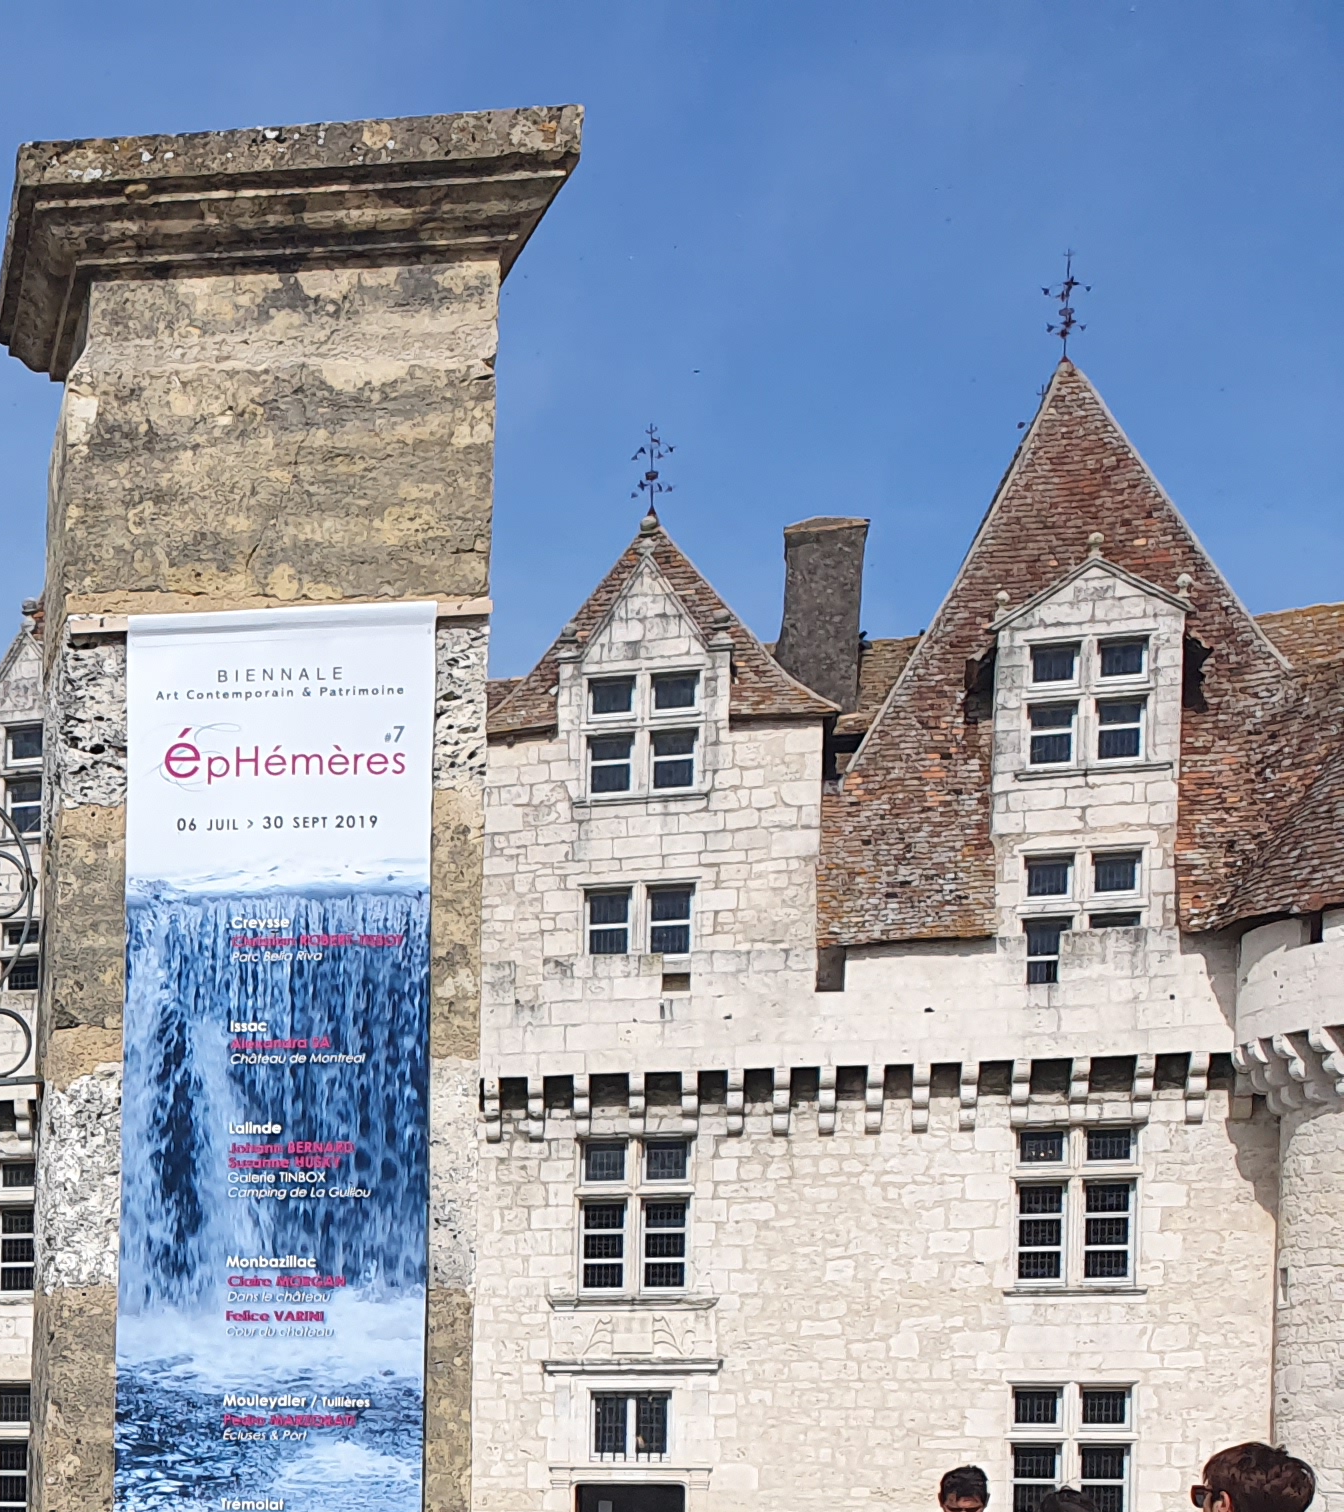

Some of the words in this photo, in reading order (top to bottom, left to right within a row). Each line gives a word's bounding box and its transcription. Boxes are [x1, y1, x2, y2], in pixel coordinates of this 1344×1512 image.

[217, 666, 344, 683] BIENNALE
[156, 690, 180, 701] Art
[186, 687, 294, 701] Contemporain
[302, 686, 312, 698] &
[319, 685, 404, 697] Patrimoine
[384, 725, 406, 743] #7
[164, 727, 406, 785] épHémères
[176, 817, 197, 832] 06
[206, 818, 239, 831] JUIL
[262, 815, 284, 830] 30
[292, 815, 328, 829] SEPT
[334, 814, 379, 829] 2019
[231, 917, 290, 930] Creysse
[231, 951, 259, 963] Parc
[296, 950, 323, 962] Riva
[230, 1020, 268, 1033] Issac
[230, 1037, 308, 1050] Alexandra
[230, 1052, 286, 1065] Château
[289, 1052, 307, 1064] de
[229, 1121, 282, 1135] Lalinde
[228, 1142, 284, 1155] Johann
[287, 1141, 356, 1154] BERNARD
[228, 1156, 290, 1169] Suzanne
[295, 1155, 341, 1168] HUSKY
[227, 1171, 276, 1184] Galerie
[278, 1171, 326, 1183] TINBOX
[227, 1187, 287, 1200] Camping
[289, 1187, 307, 1198] de
[310, 1187, 326, 1198] La
[225, 1255, 317, 1268] Monbazillac
[227, 1275, 272, 1288] Claire
[276, 1274, 347, 1288] MORGAN
[227, 1291, 259, 1303] Dans
[262, 1291, 272, 1303] le
[276, 1291, 331, 1303] château
[225, 1310, 270, 1322] Felice
[273, 1310, 325, 1323] VARINI
[225, 1326, 256, 1338] Cour
[259, 1326, 276, 1337] du
[279, 1325, 334, 1338] château
[223, 1394, 307, 1409] Mouleydier
[310, 1394, 318, 1408] /
[269, 1430, 279, 1440] &
[282, 1430, 308, 1441] Port
[220, 1497, 285, 1511] Trémolat
